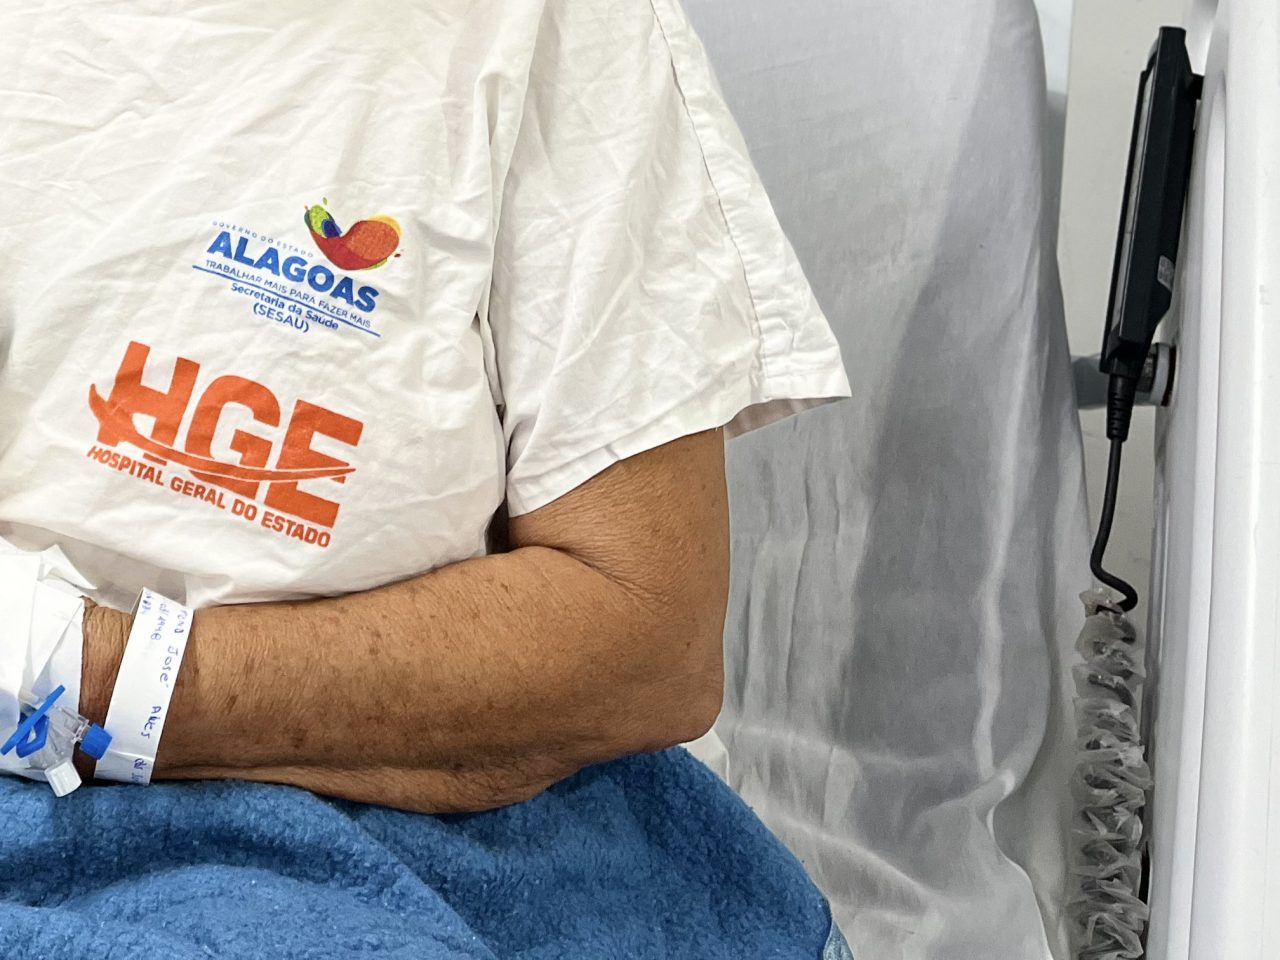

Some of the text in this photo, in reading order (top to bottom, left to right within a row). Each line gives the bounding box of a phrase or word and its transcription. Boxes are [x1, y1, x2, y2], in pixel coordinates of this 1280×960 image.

[206, 230, 380, 314] ALAGOAS
[212, 220, 315, 259] GOVERNO DO ESTADO
[205, 259, 372, 329] TRABALHAR MAIS PARA FAZER MAIS
[231, 282, 339, 331] Secretaria da Saúde
[253, 301, 310, 334] (SESAU)
[89, 340, 364, 529] HGE
[86, 445, 332, 550] HOSPITAL GERAL DO ESTADO
